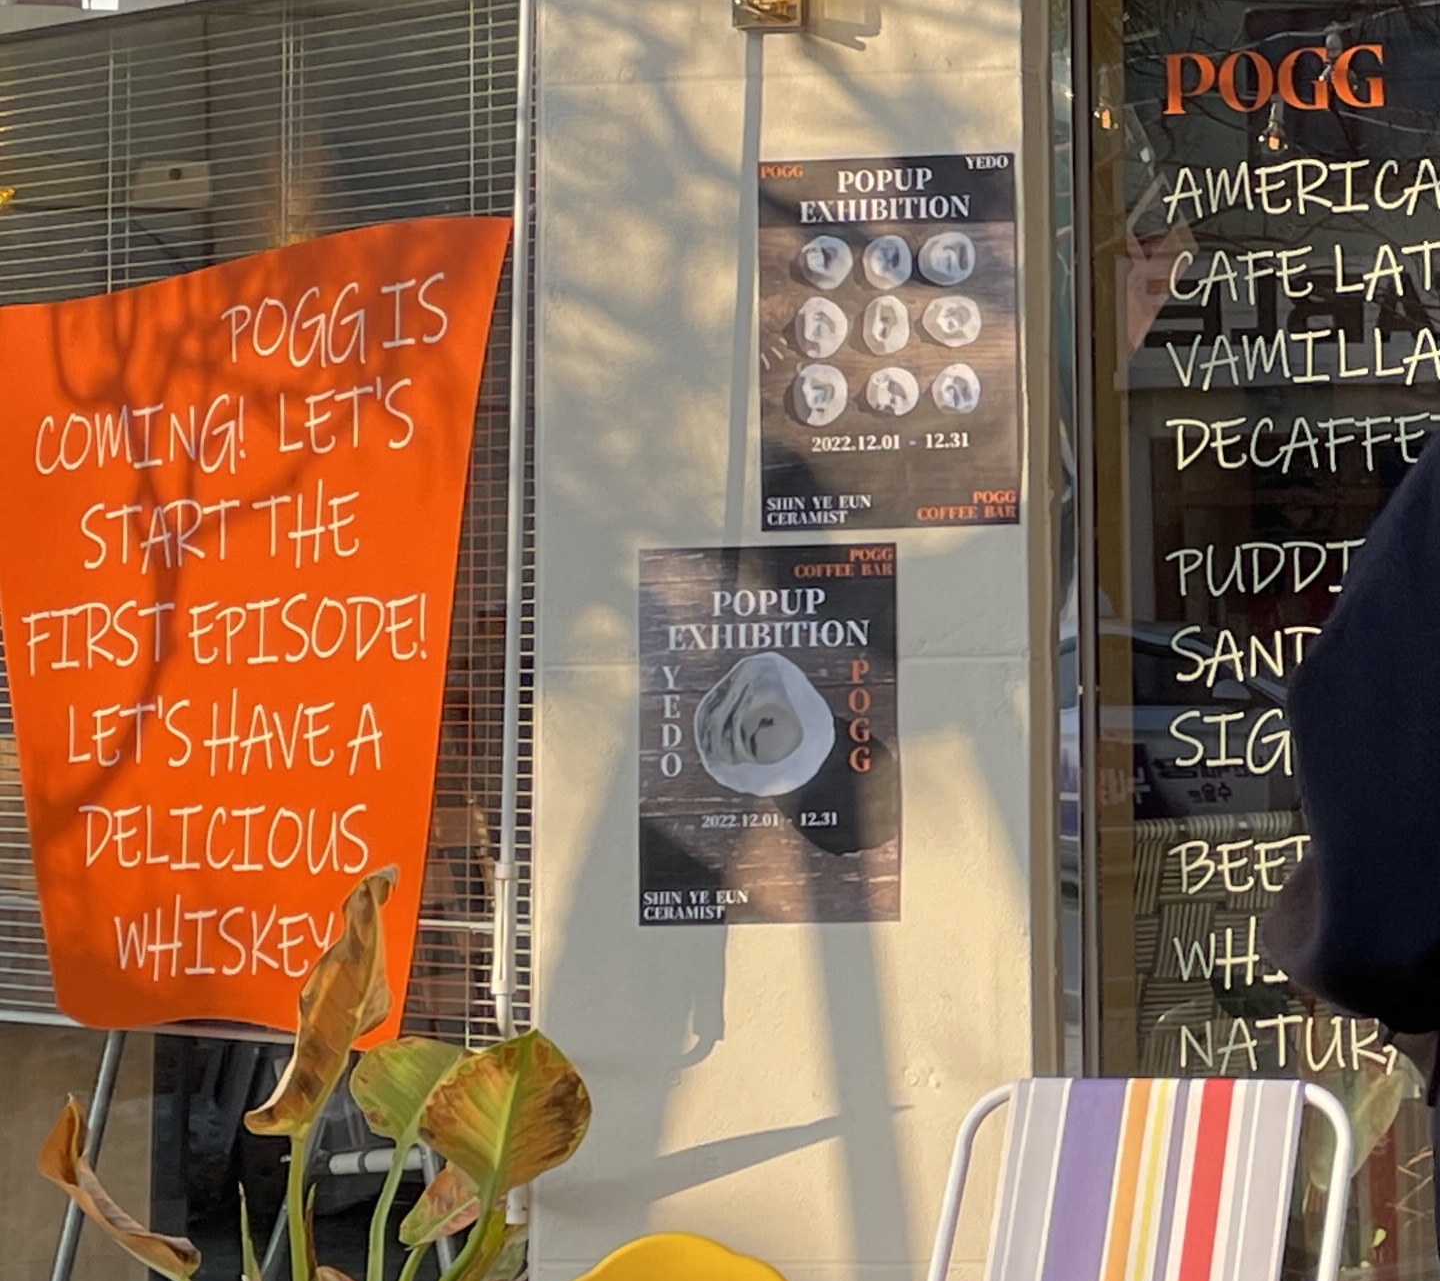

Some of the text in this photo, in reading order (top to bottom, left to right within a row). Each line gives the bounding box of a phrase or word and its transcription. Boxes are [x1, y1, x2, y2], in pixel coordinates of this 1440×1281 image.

[1163, 43, 1386, 115] POGG
[759, 164, 804, 179] POGG
[965, 155, 1009, 169] YEDO
[837, 167, 933, 193] POPUP
[800, 194, 970, 224] EXHIBITION
[1168, 245, 1313, 308] CAFE
[222, 272, 449, 367] POGG IS
[34, 377, 414, 476] COMING! LET'S
[811, 434, 900, 453] 2022.12.01
[925, 432, 970, 450] 12.31
[767, 494, 872, 511] SHIN YE EUN
[972, 490, 1017, 504] POGG
[82, 477, 361, 575] START THE
[767, 510, 848, 526] CERAMIST
[916, 504, 1017, 521] COFFEE BAR
[849, 547, 893, 562] POGG
[794, 562, 893, 579] COFFEE BAR
[711, 587, 826, 617] POPUP
[21, 591, 429, 677] FIRST EPISODE!
[668, 619, 870, 651] EXHIBITION
[660, 665, 683, 778] YEDO
[848, 658, 873, 773] POGG
[67, 687, 384, 777] LET'S HAVE A
[701, 813, 779, 829] 2022.12.01
[800, 812, 838, 827] 12.31
[79, 802, 369, 875] DELICIOUS
[643, 889, 749, 905] SHIN YE EUN
[643, 905, 725, 920] CERAMIST
[114, 895, 335, 983] WHISKEY
[1173, 915, 1289, 990] WH
